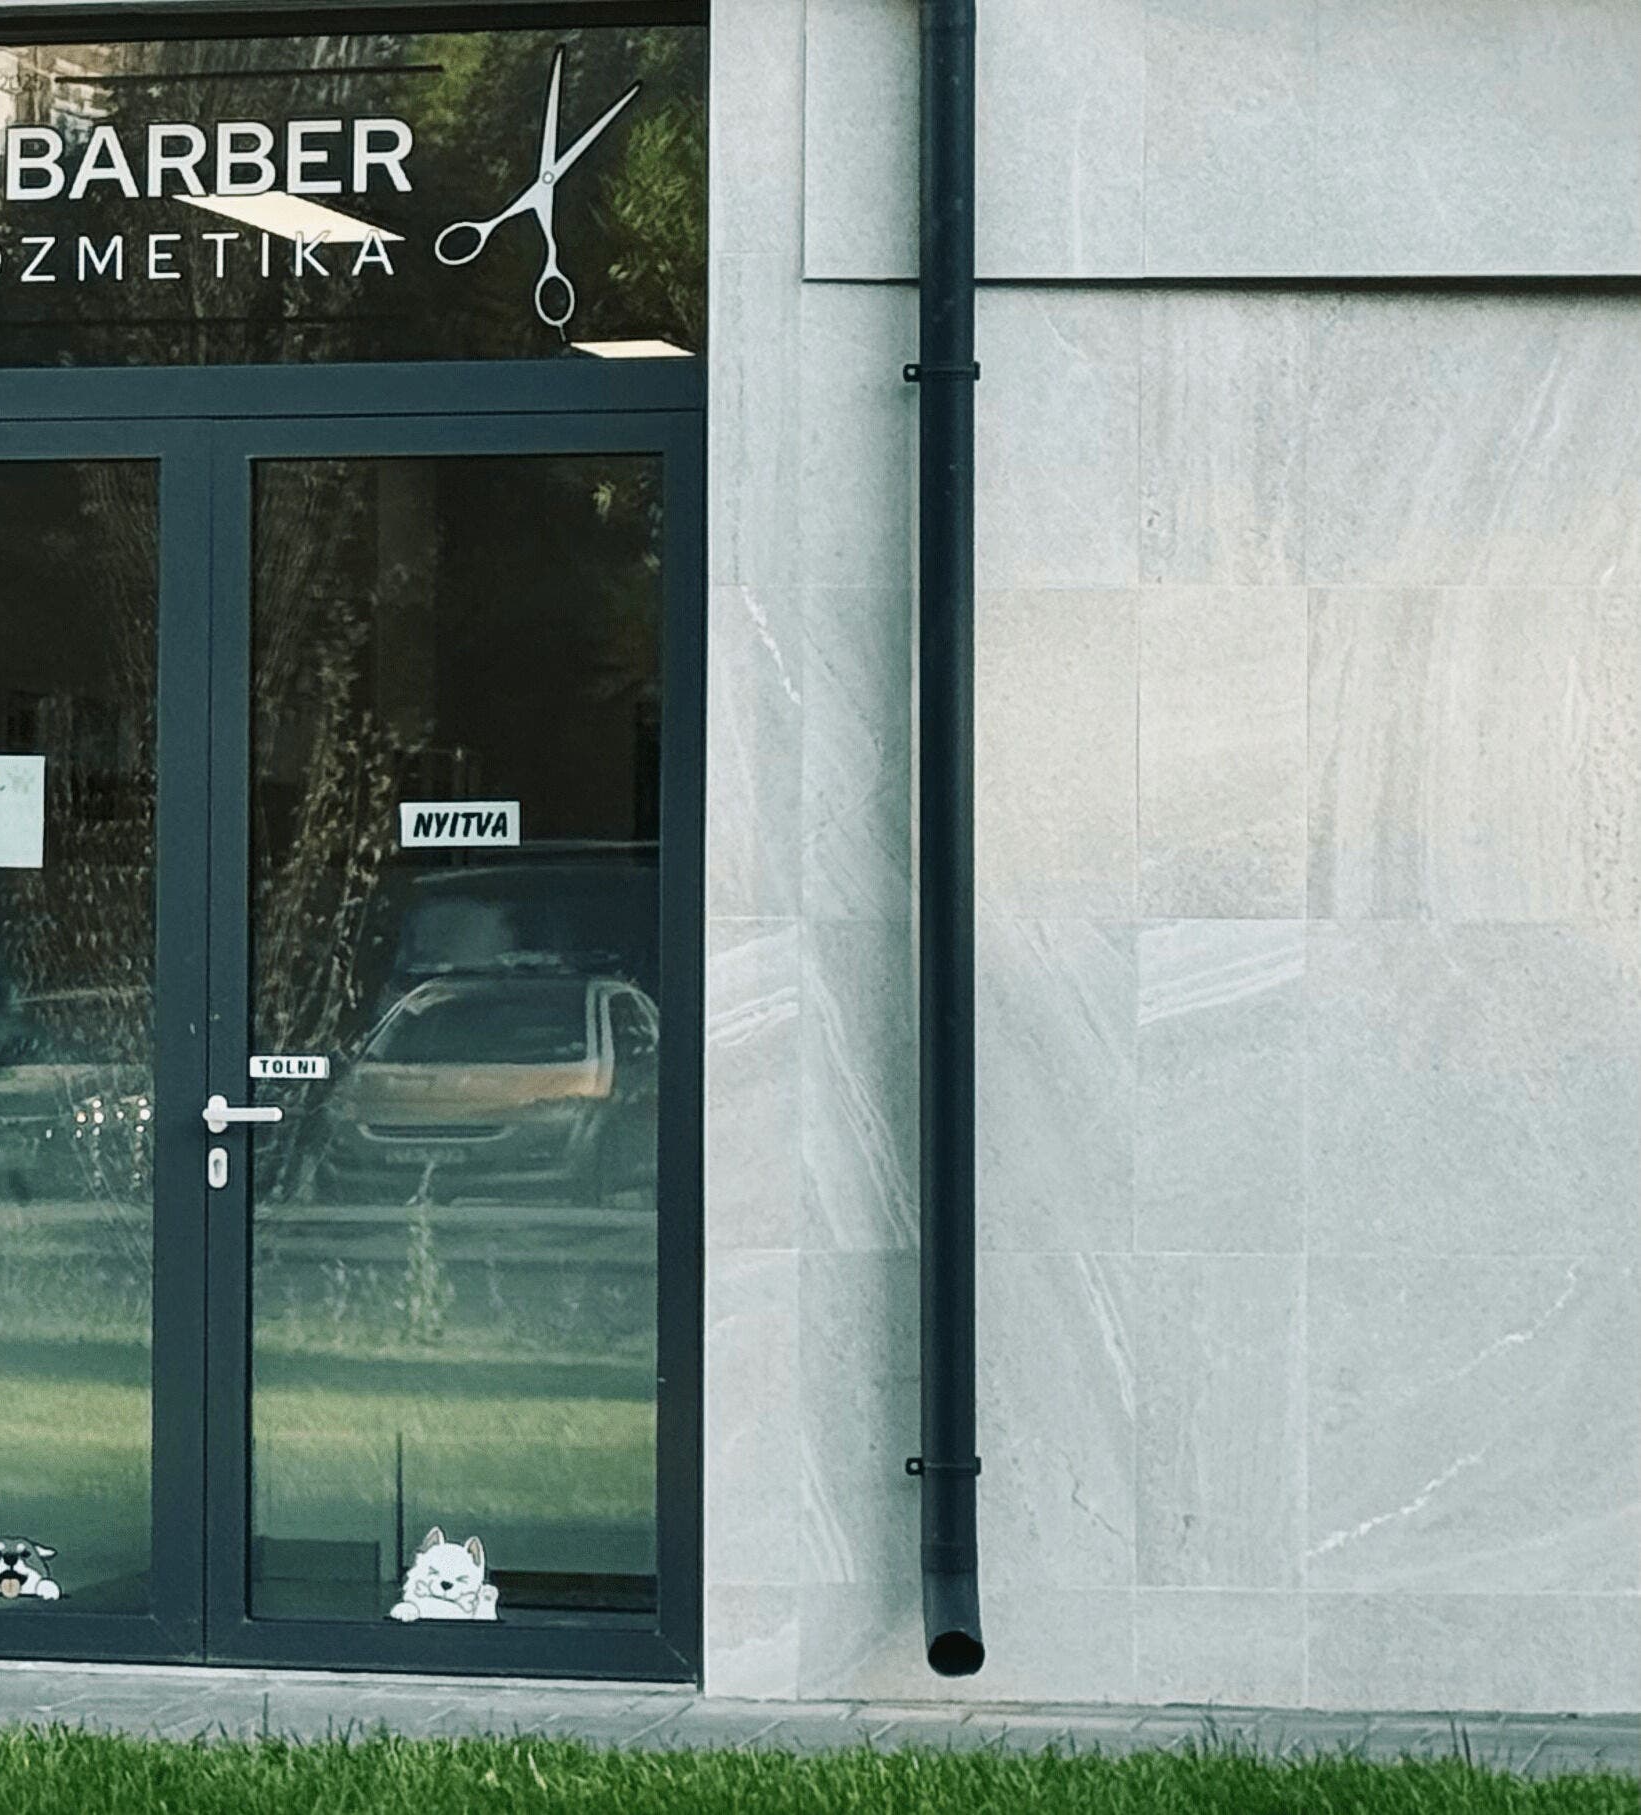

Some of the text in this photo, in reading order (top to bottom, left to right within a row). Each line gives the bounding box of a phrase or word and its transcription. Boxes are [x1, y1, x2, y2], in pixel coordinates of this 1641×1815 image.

[5, 119, 413, 201] BARBER
[413, 811, 508, 838] NYITVA
[259, 1059, 317, 1074] TOLNI
